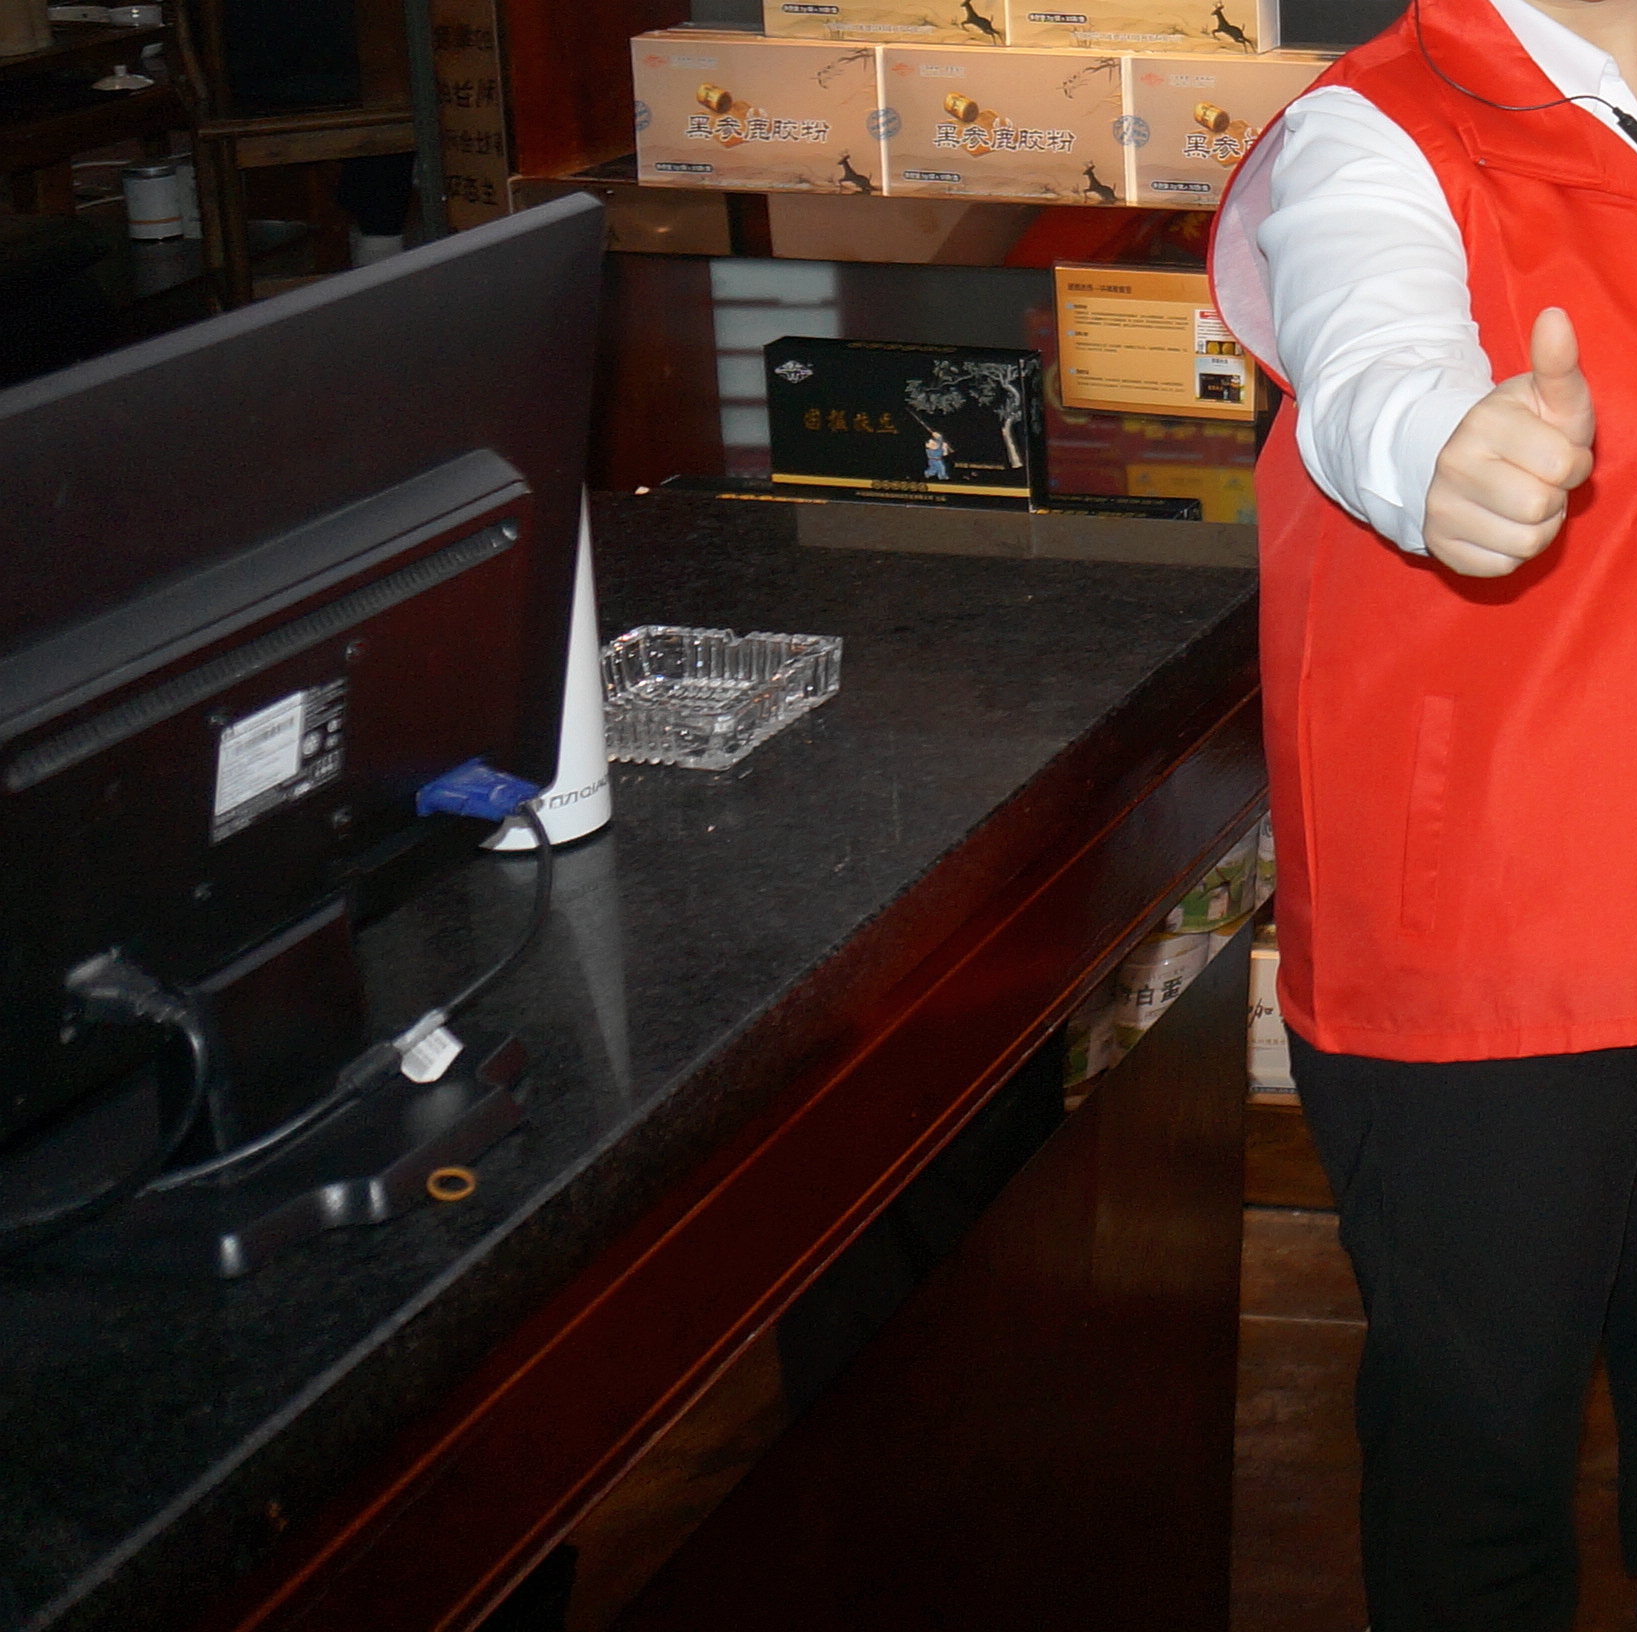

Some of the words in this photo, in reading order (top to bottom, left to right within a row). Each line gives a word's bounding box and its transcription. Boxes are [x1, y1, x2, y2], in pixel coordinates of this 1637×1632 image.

[685, 115, 831, 143] 黑参鹿胶粉
[933, 123, 1076, 154] 黑参鹿胶粉
